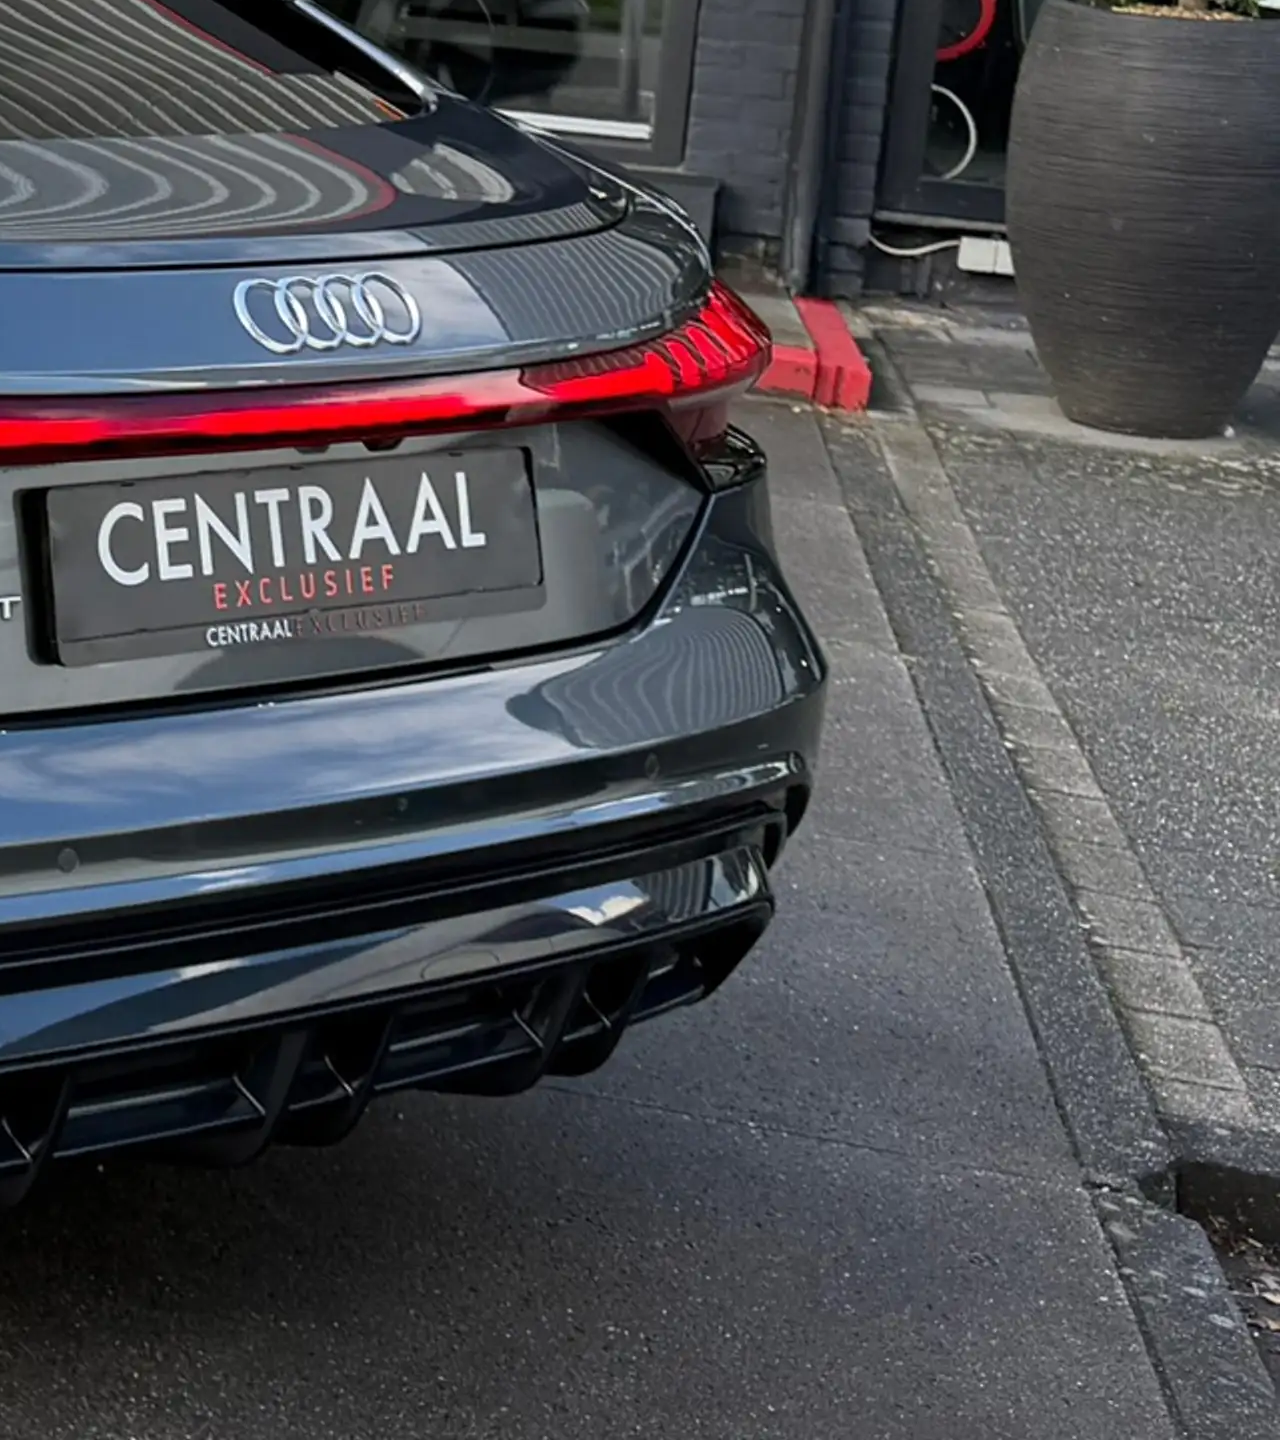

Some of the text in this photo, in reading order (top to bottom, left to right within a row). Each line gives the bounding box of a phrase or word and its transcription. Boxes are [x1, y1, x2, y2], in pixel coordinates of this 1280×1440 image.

[97, 471, 487, 586] CENTRAAL
[212, 563, 395, 609] EXCLUSIEF
[206, 603, 429, 648] CENTRAAL EXCLUSIEF
